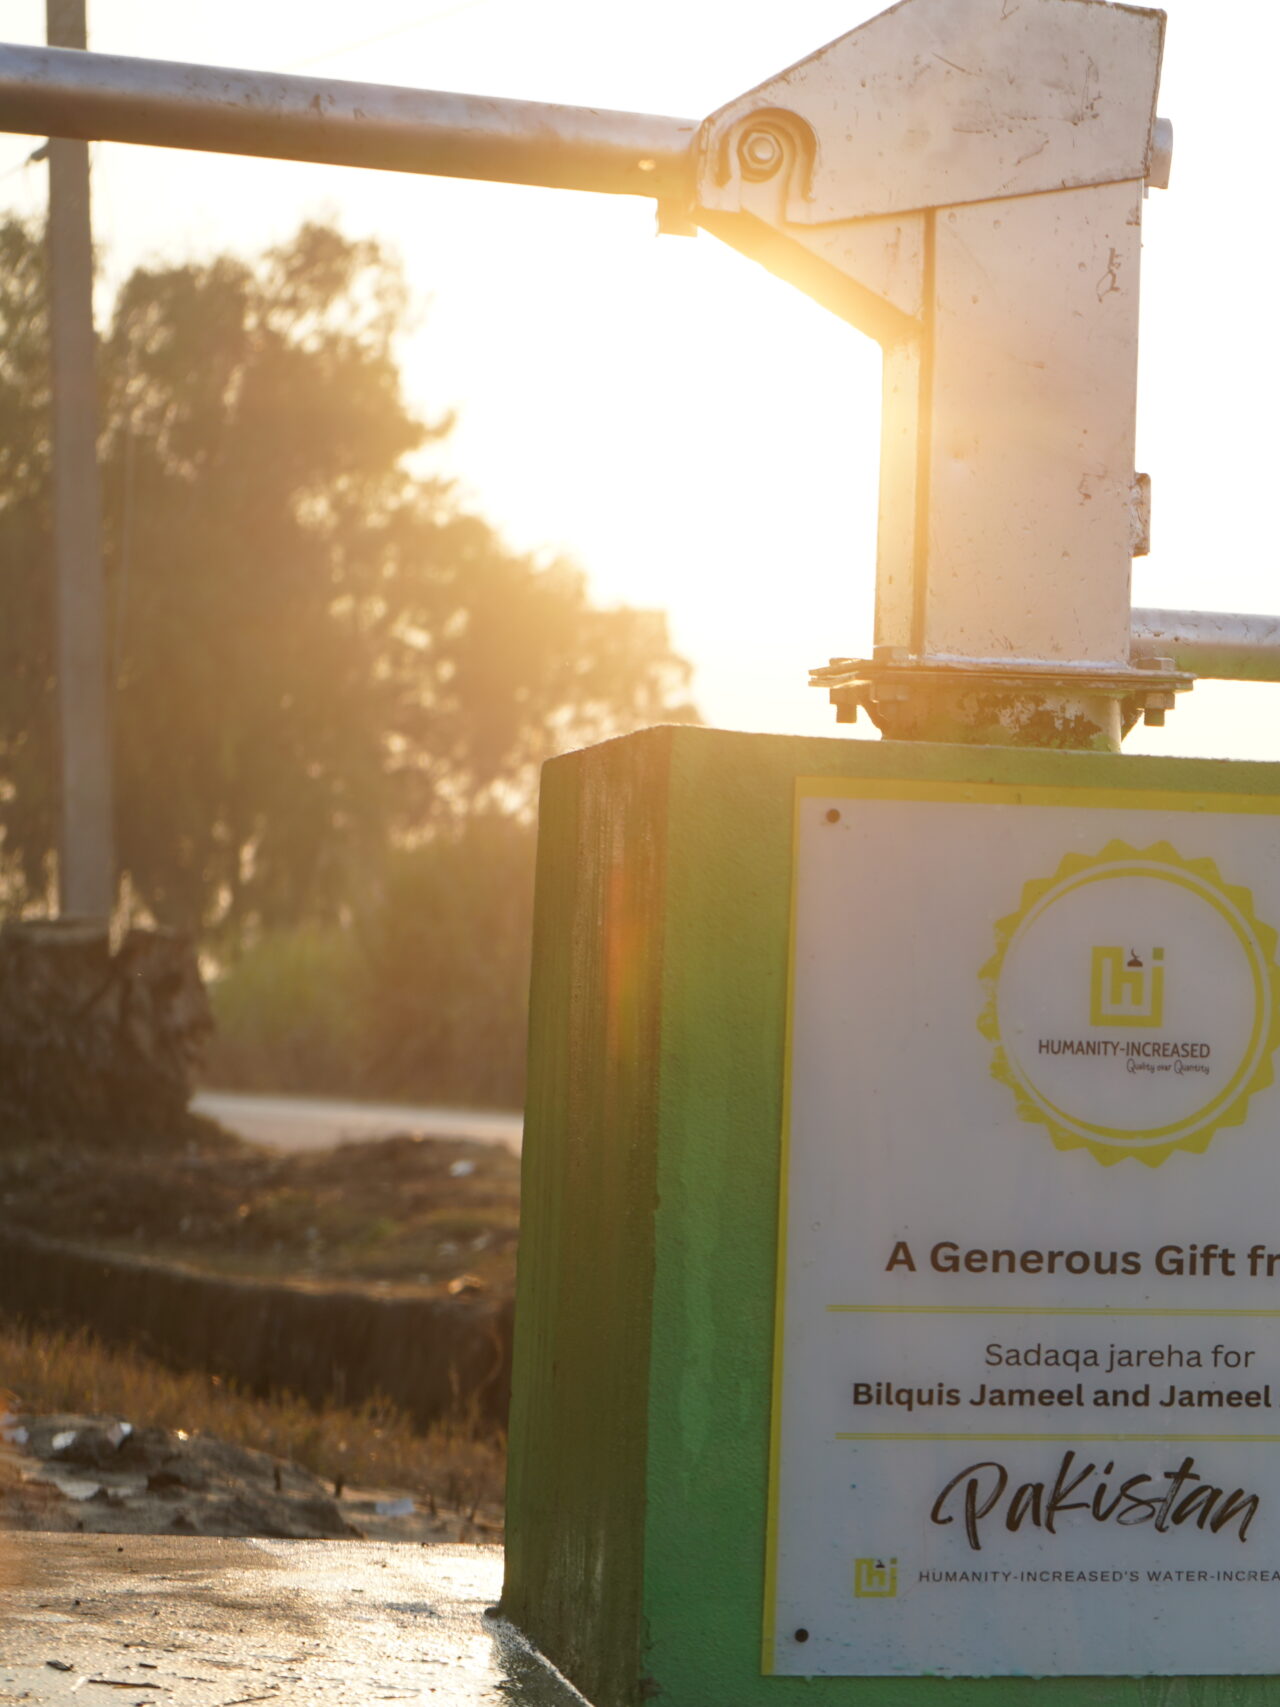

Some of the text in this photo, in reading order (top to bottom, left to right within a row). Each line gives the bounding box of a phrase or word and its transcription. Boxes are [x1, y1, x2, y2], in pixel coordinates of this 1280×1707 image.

[1038, 1040, 1211, 1058] HUMANITY-INCREASED
[1126, 1058, 1210, 1076] Quality over Quantity
[885, 1241, 917, 1272] A
[930, 1241, 1142, 1276] Generous
[1155, 1244, 1236, 1277] Gift
[985, 1343, 1256, 1373] Sadaqa jareha for
[852, 1382, 961, 1412] Bilquis
[969, 1383, 1085, 1408] Jameel
[1092, 1384, 1150, 1408] and
[1158, 1385, 1272, 1409] Jameel
[930, 1450, 1260, 1551] Pakistan
[918, 1570, 1140, 1583] HUMANITY-INCREASED'S
